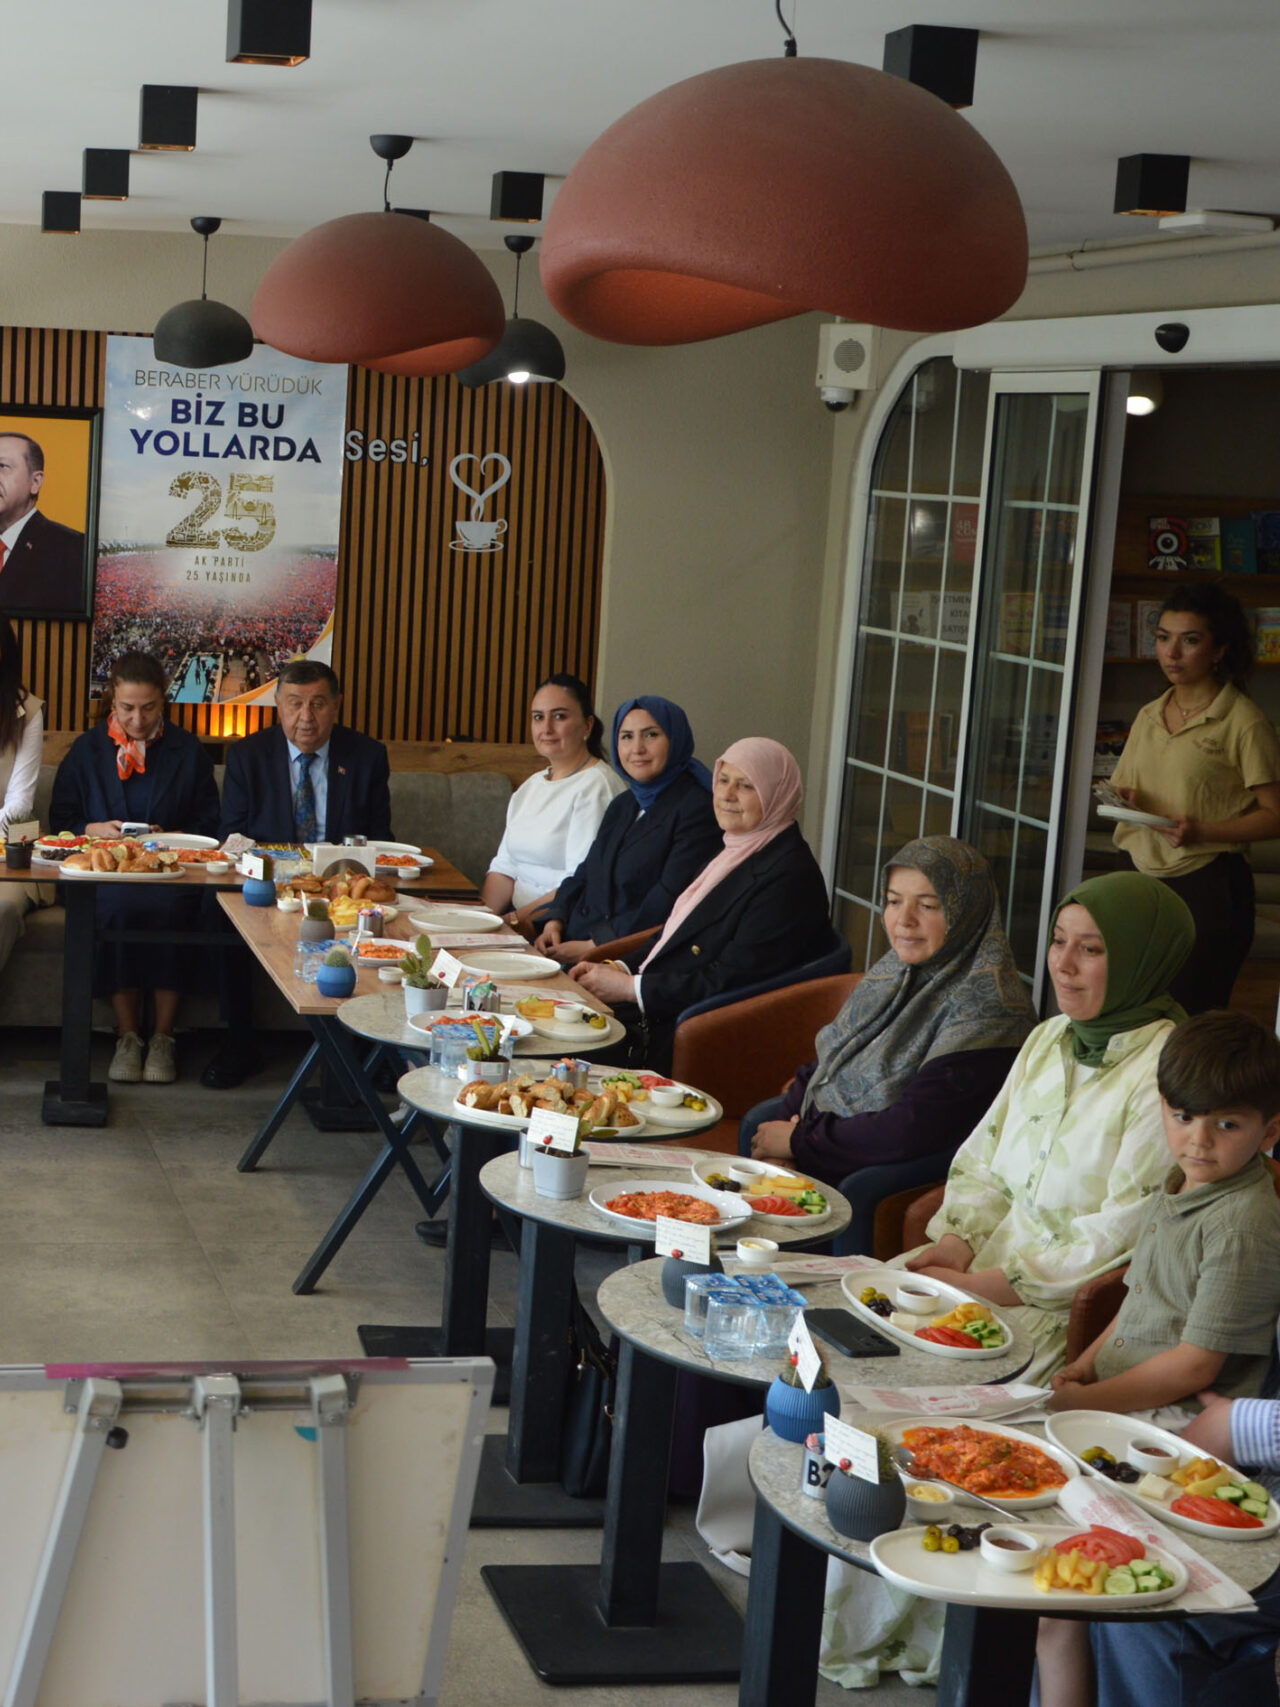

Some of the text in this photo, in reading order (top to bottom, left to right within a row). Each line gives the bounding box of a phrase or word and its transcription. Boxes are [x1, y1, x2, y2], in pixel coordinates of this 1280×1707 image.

[135, 369, 323, 396] BERABER YÜRÜDÜK
[171, 392, 285, 429] BİZ BU
[129, 428, 322, 464] YOLLARDA
[345, 430, 429, 467] Sesi,
[165, 470, 277, 553] 25
[186, 570, 251, 584] 25 YAŞINDA
[194, 555, 208, 566] AK
